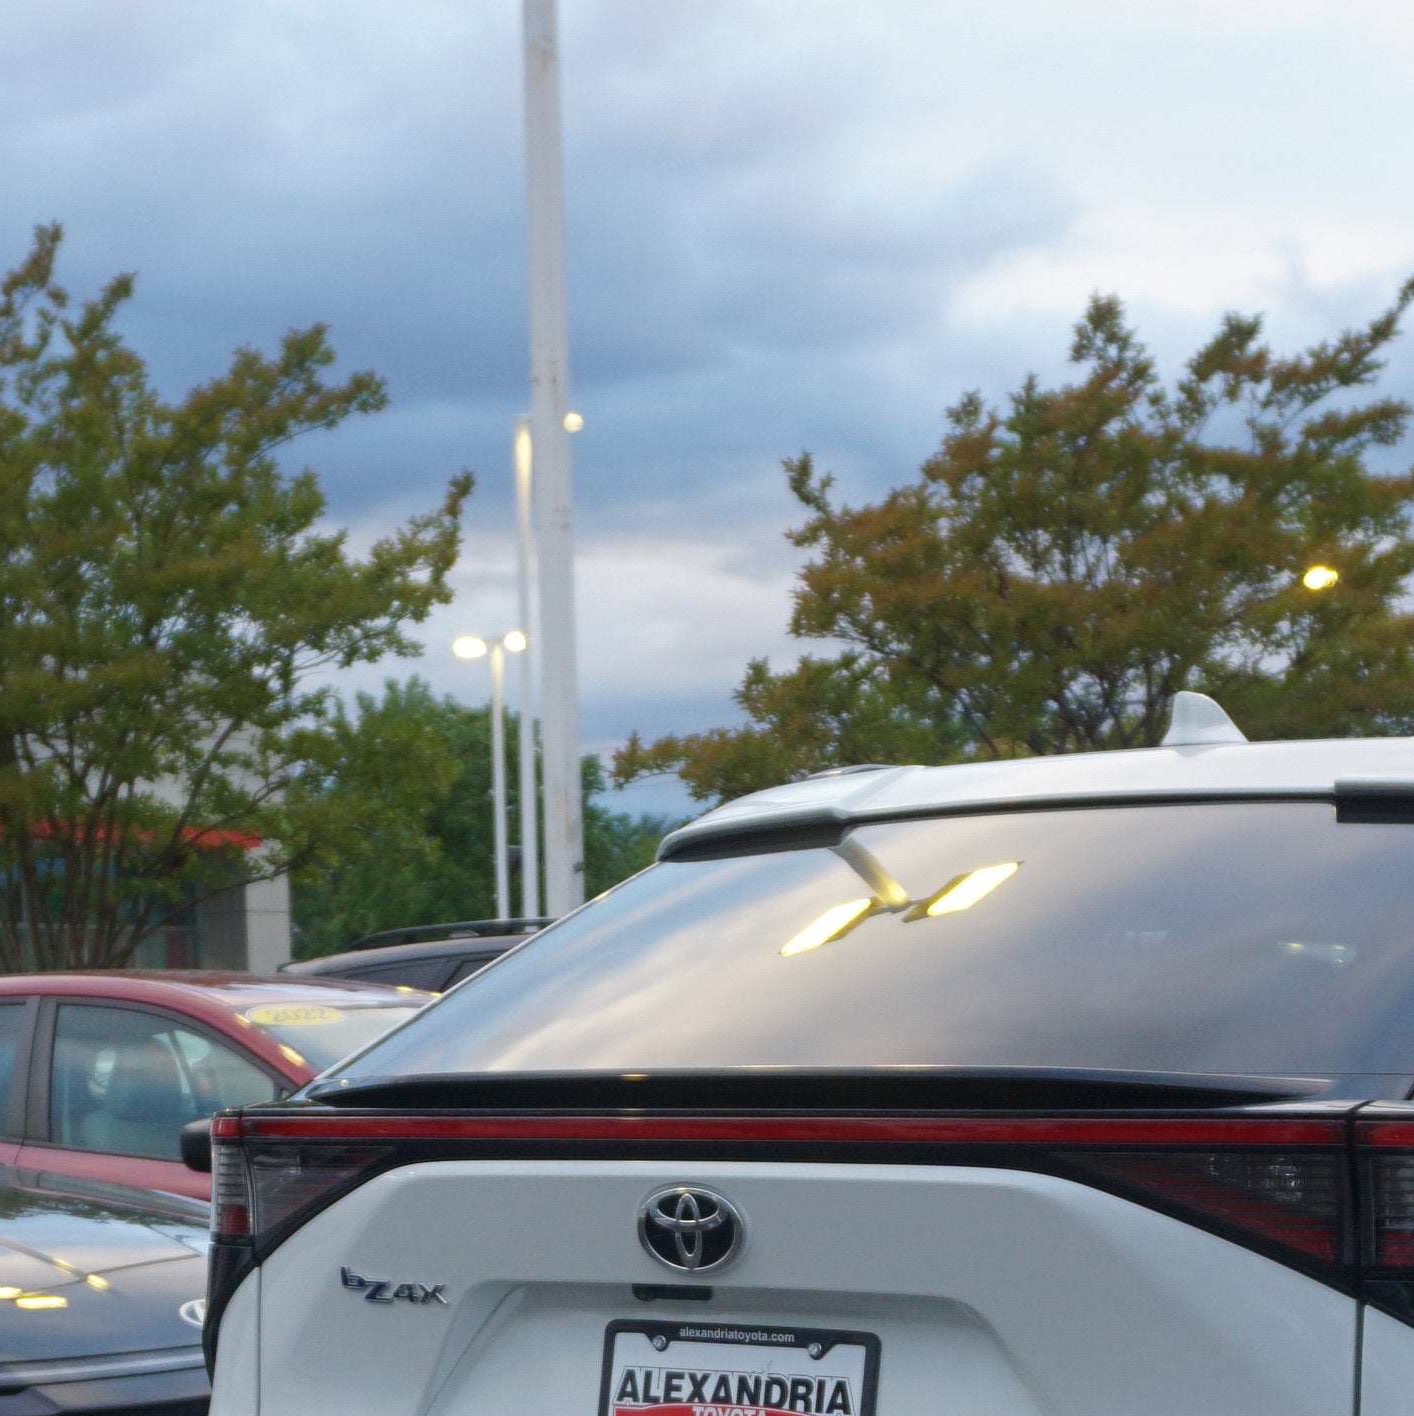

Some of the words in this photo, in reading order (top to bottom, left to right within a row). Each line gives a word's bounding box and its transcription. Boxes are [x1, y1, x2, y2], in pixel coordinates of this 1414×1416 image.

[266, 1007, 327, 1022] 2022
[340, 1264, 448, 1305] bZ4X
[679, 1326, 795, 1343] alexandriatoyota.com
[616, 1368, 854, 1416] ALEXANDRIA
